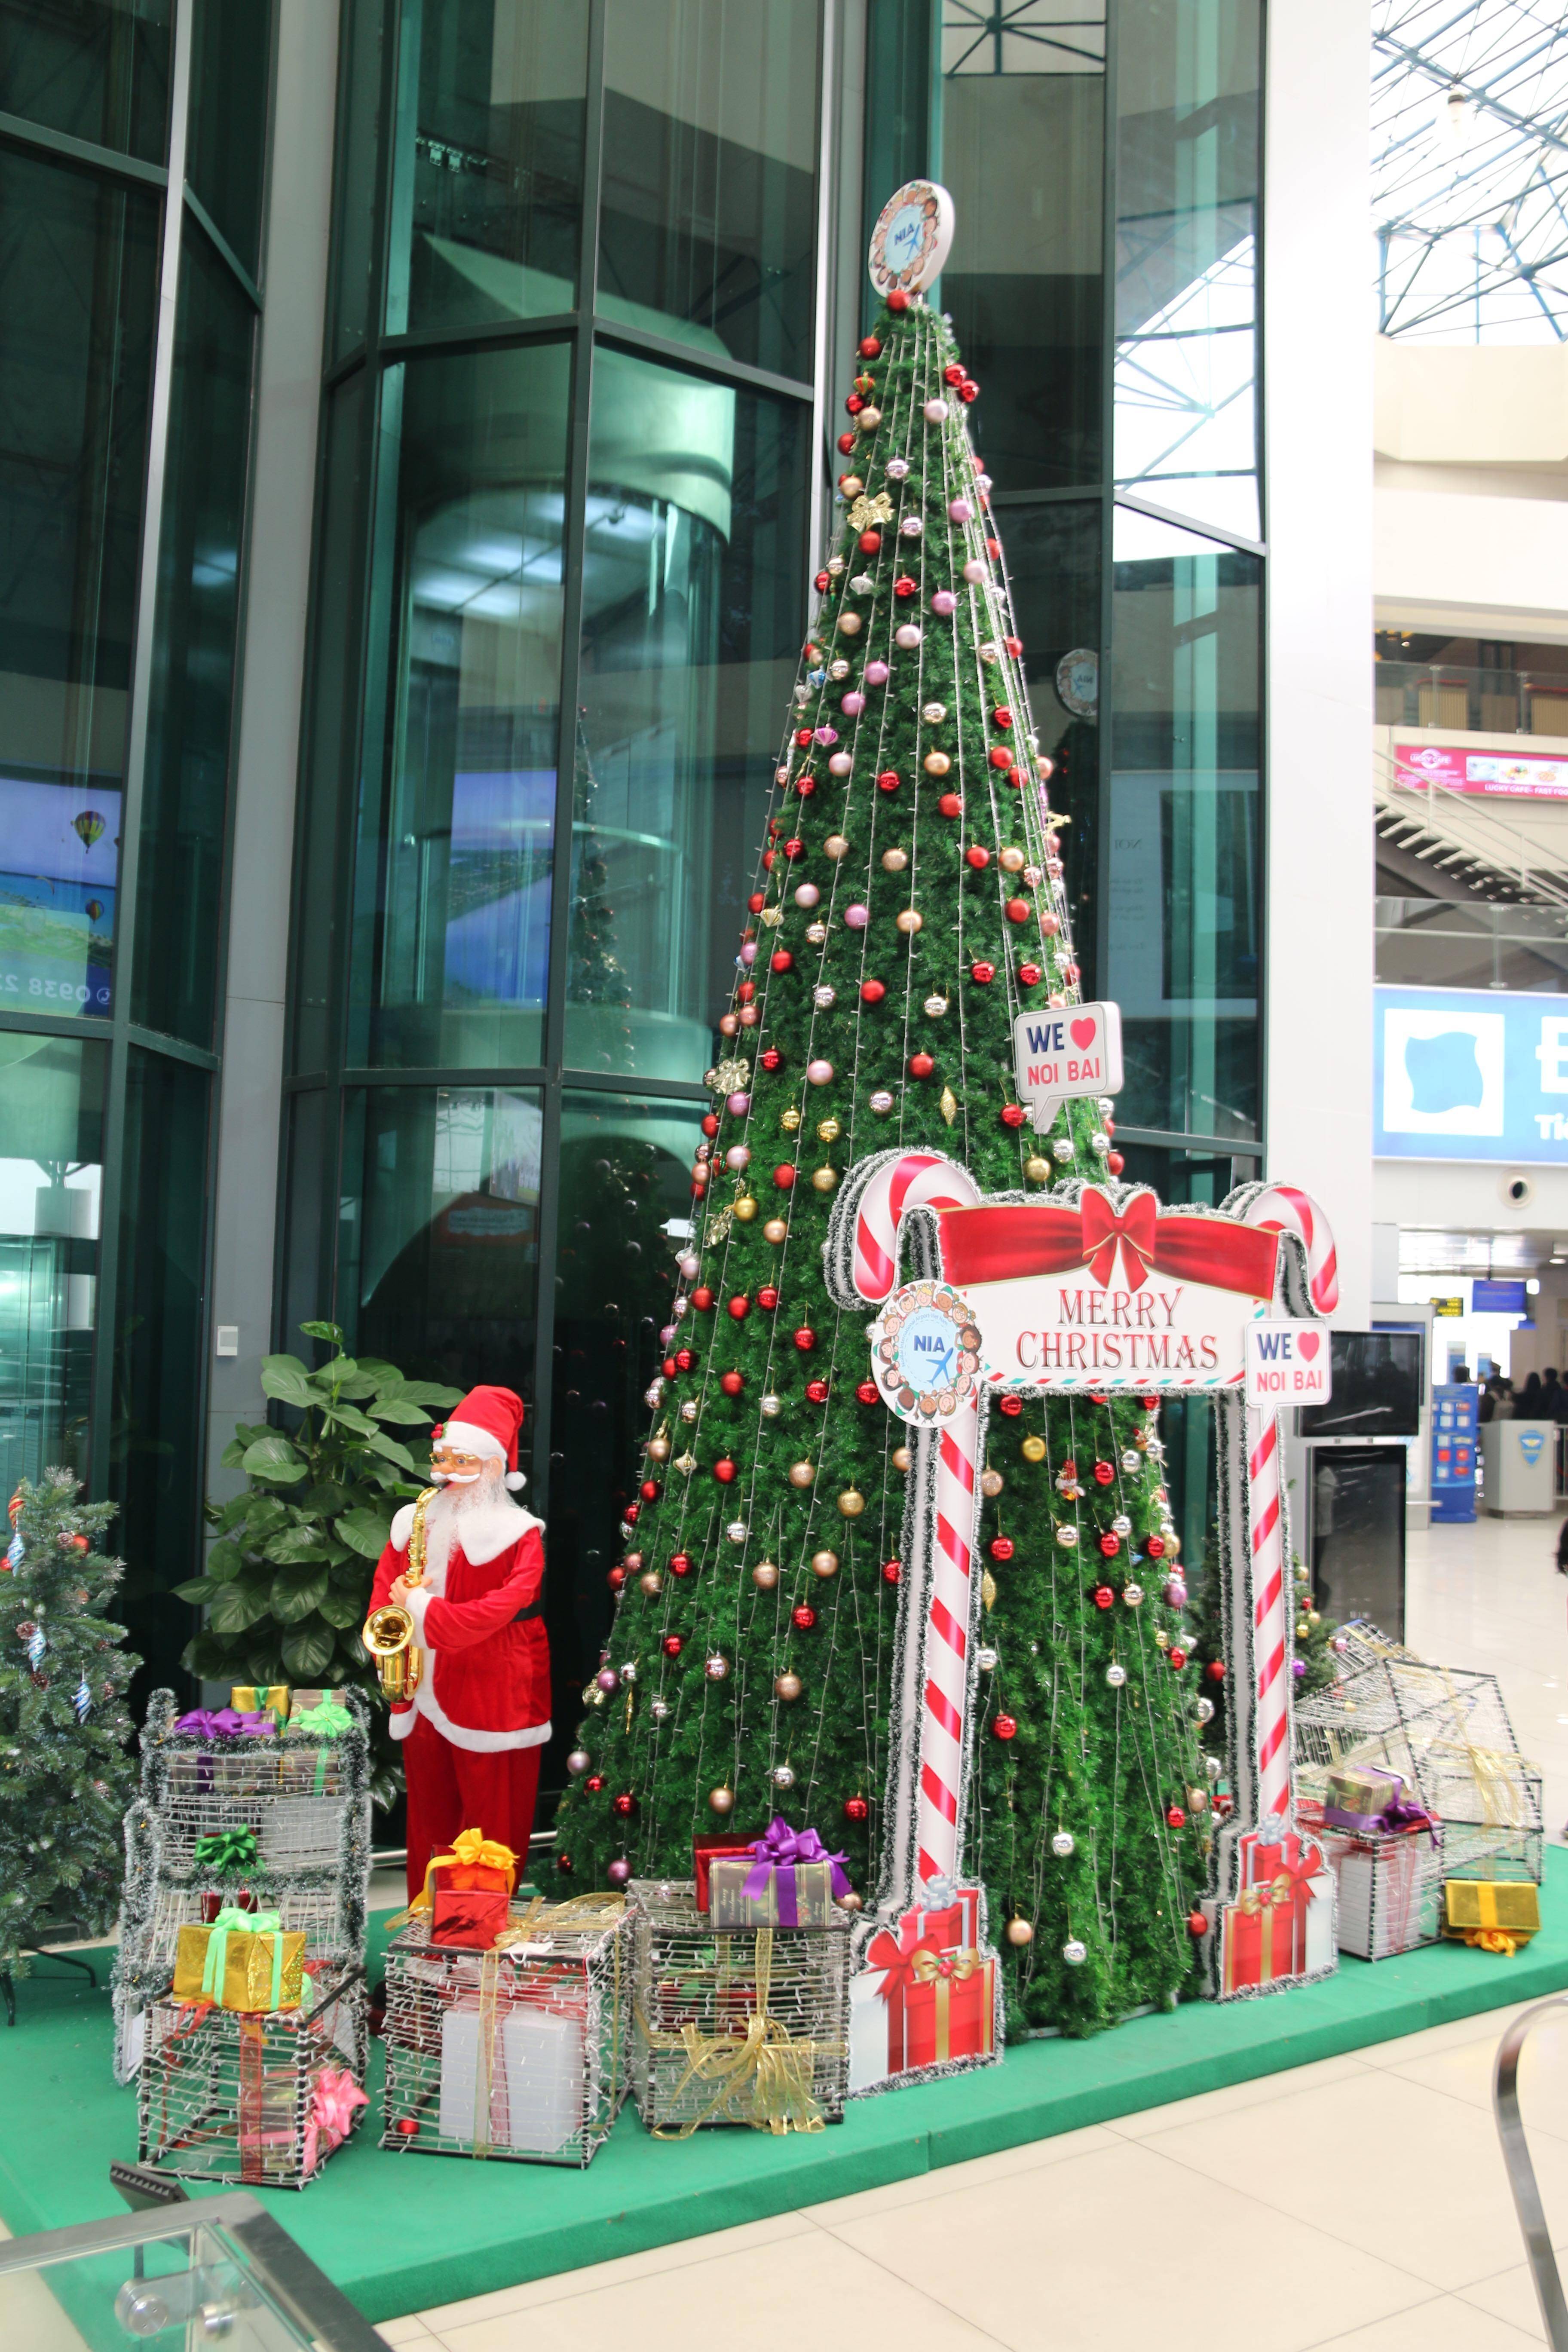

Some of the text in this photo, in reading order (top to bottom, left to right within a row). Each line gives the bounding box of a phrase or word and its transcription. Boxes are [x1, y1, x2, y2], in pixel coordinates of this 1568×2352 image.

[894, 224, 914, 246] NIA
[1485, 783, 1508, 792] LUCKY
[1026, 1022, 1064, 1054] WE
[1027, 1057, 1100, 1087] NOI BAI
[1056, 1285, 1186, 1330] MERRY
[913, 1335, 945, 1353] NIA
[1015, 1330, 1219, 1372] CHRISTMAS
[1256, 1332, 1292, 1360] WE
[1256, 1369, 1322, 1392] NOI BAI
